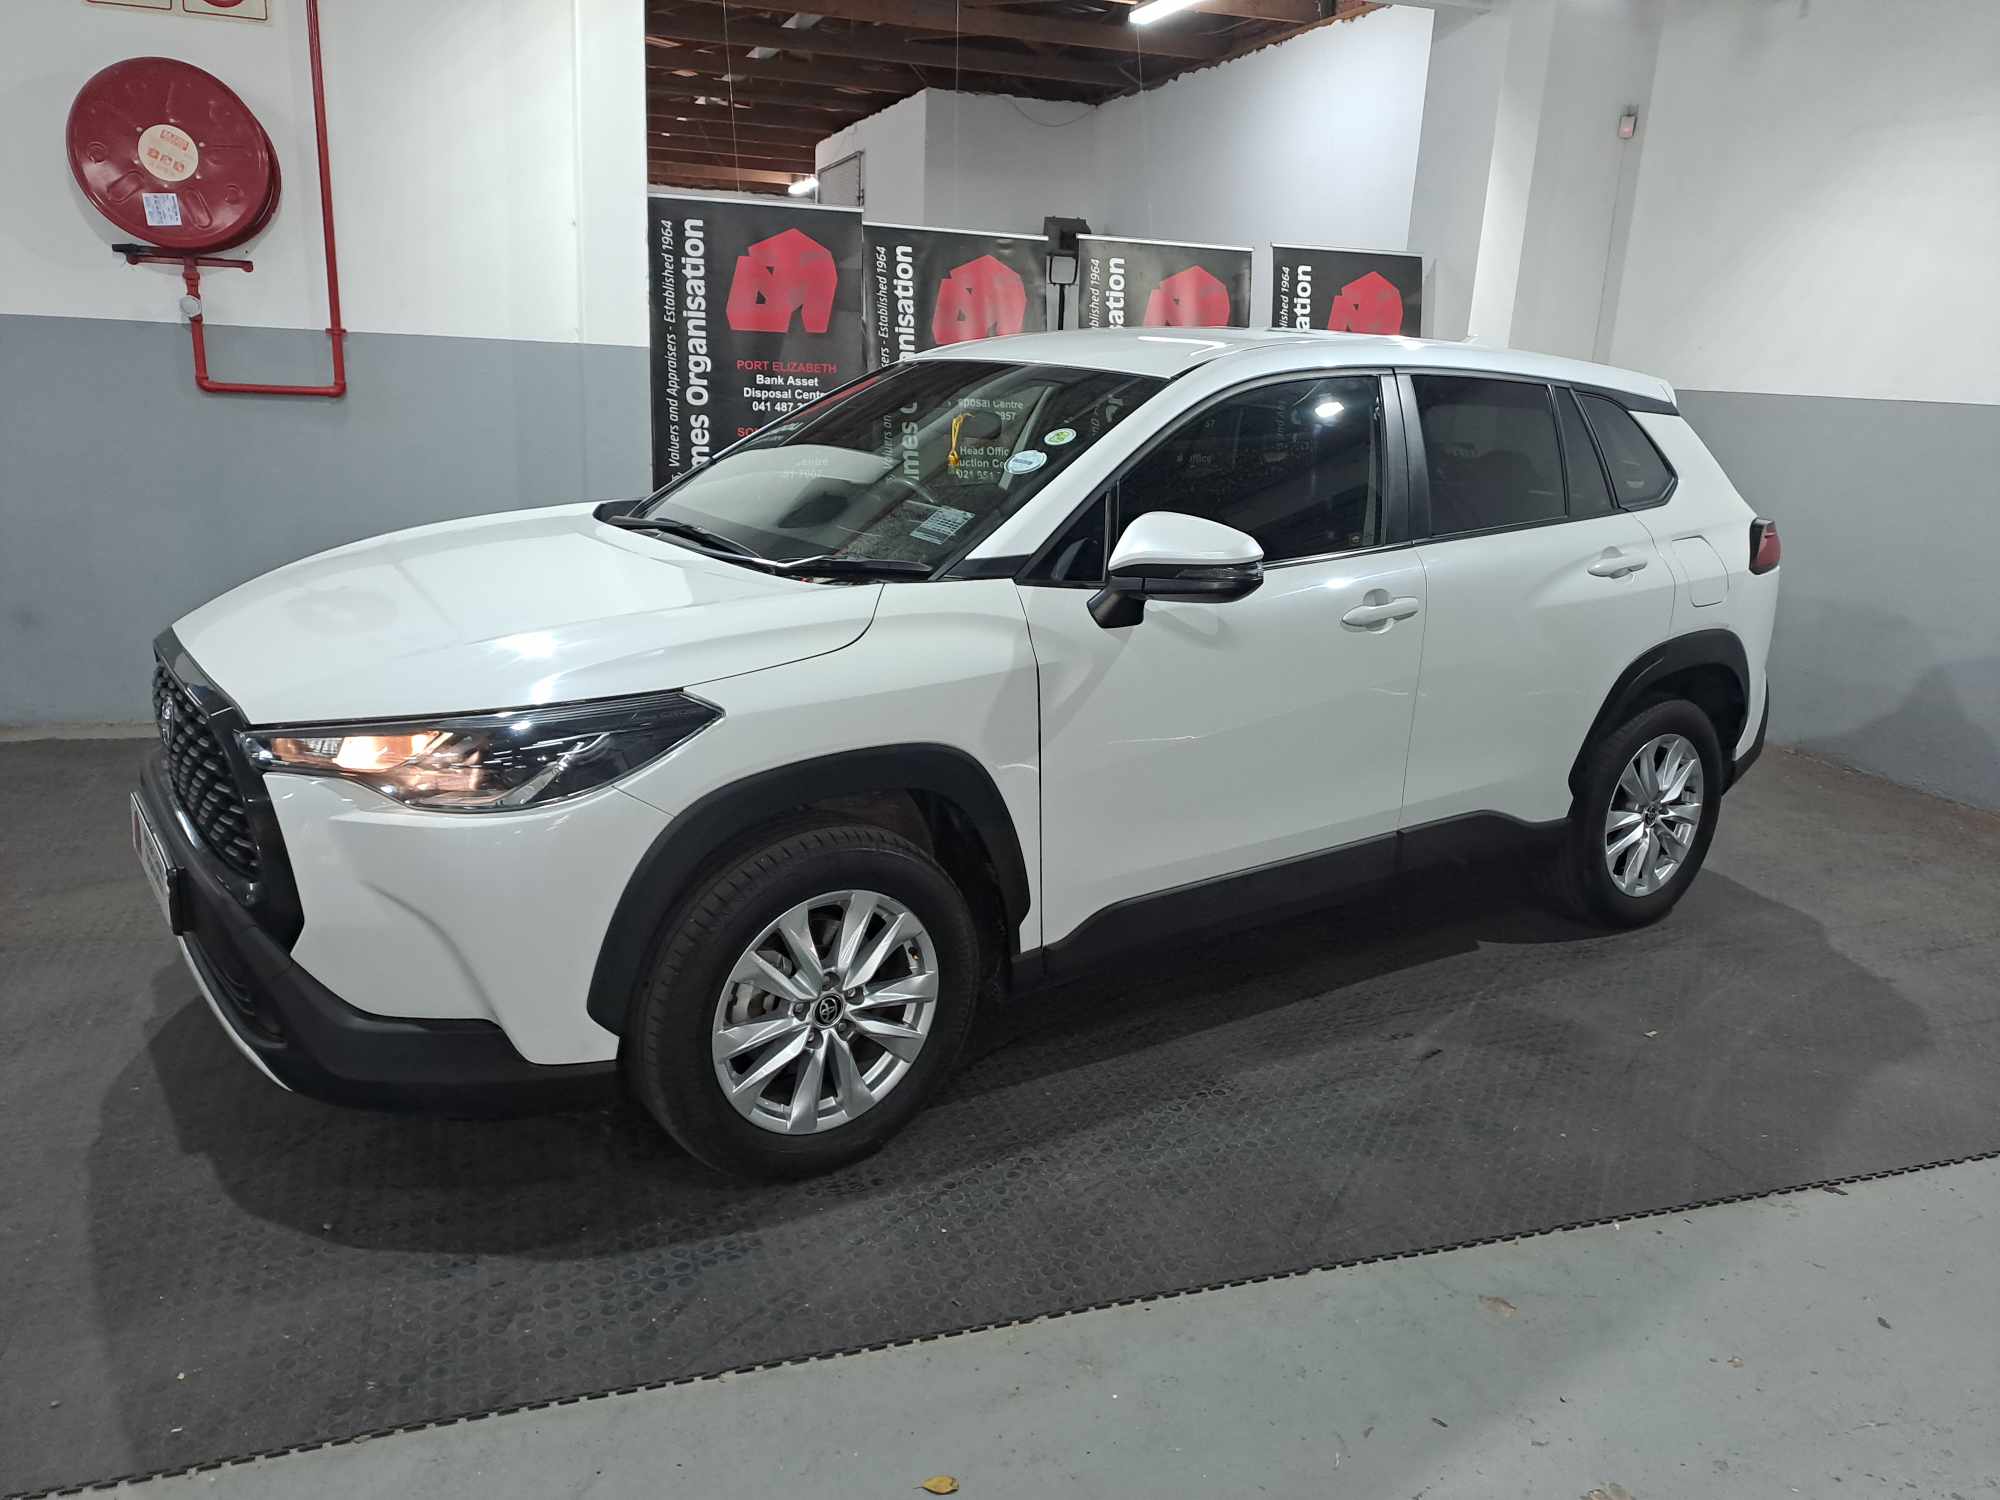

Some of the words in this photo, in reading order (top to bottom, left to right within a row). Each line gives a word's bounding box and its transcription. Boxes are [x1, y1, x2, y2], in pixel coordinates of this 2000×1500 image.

[660, 219, 673, 250] 1964
[875, 246, 887, 273] 1964
[1090, 258, 1100, 285] 1964
[661, 253, 676, 323] Established
[1105, 257, 1125, 328] ation
[1280, 266, 1290, 292] 1964
[681, 218, 712, 406] Organisation
[876, 275, 889, 338] Established
[665, 333, 680, 396] Appraisers
[736, 360, 768, 370] PORT
[772, 361, 837, 374] ELIZABETH
[743, 387, 792, 399] Disposal
[756, 374, 784, 385] Bank
[786, 375, 818, 387] Asset
[666, 398, 679, 422] and
[752, 401, 771, 411] 041
[774, 401, 793, 412] 487
[992, 399, 1024, 409] Centre
[667, 424, 680, 467] Valuers
[902, 422, 920, 480] mes
[960, 446, 984, 456] Head
[959, 459, 989, 468] uction
